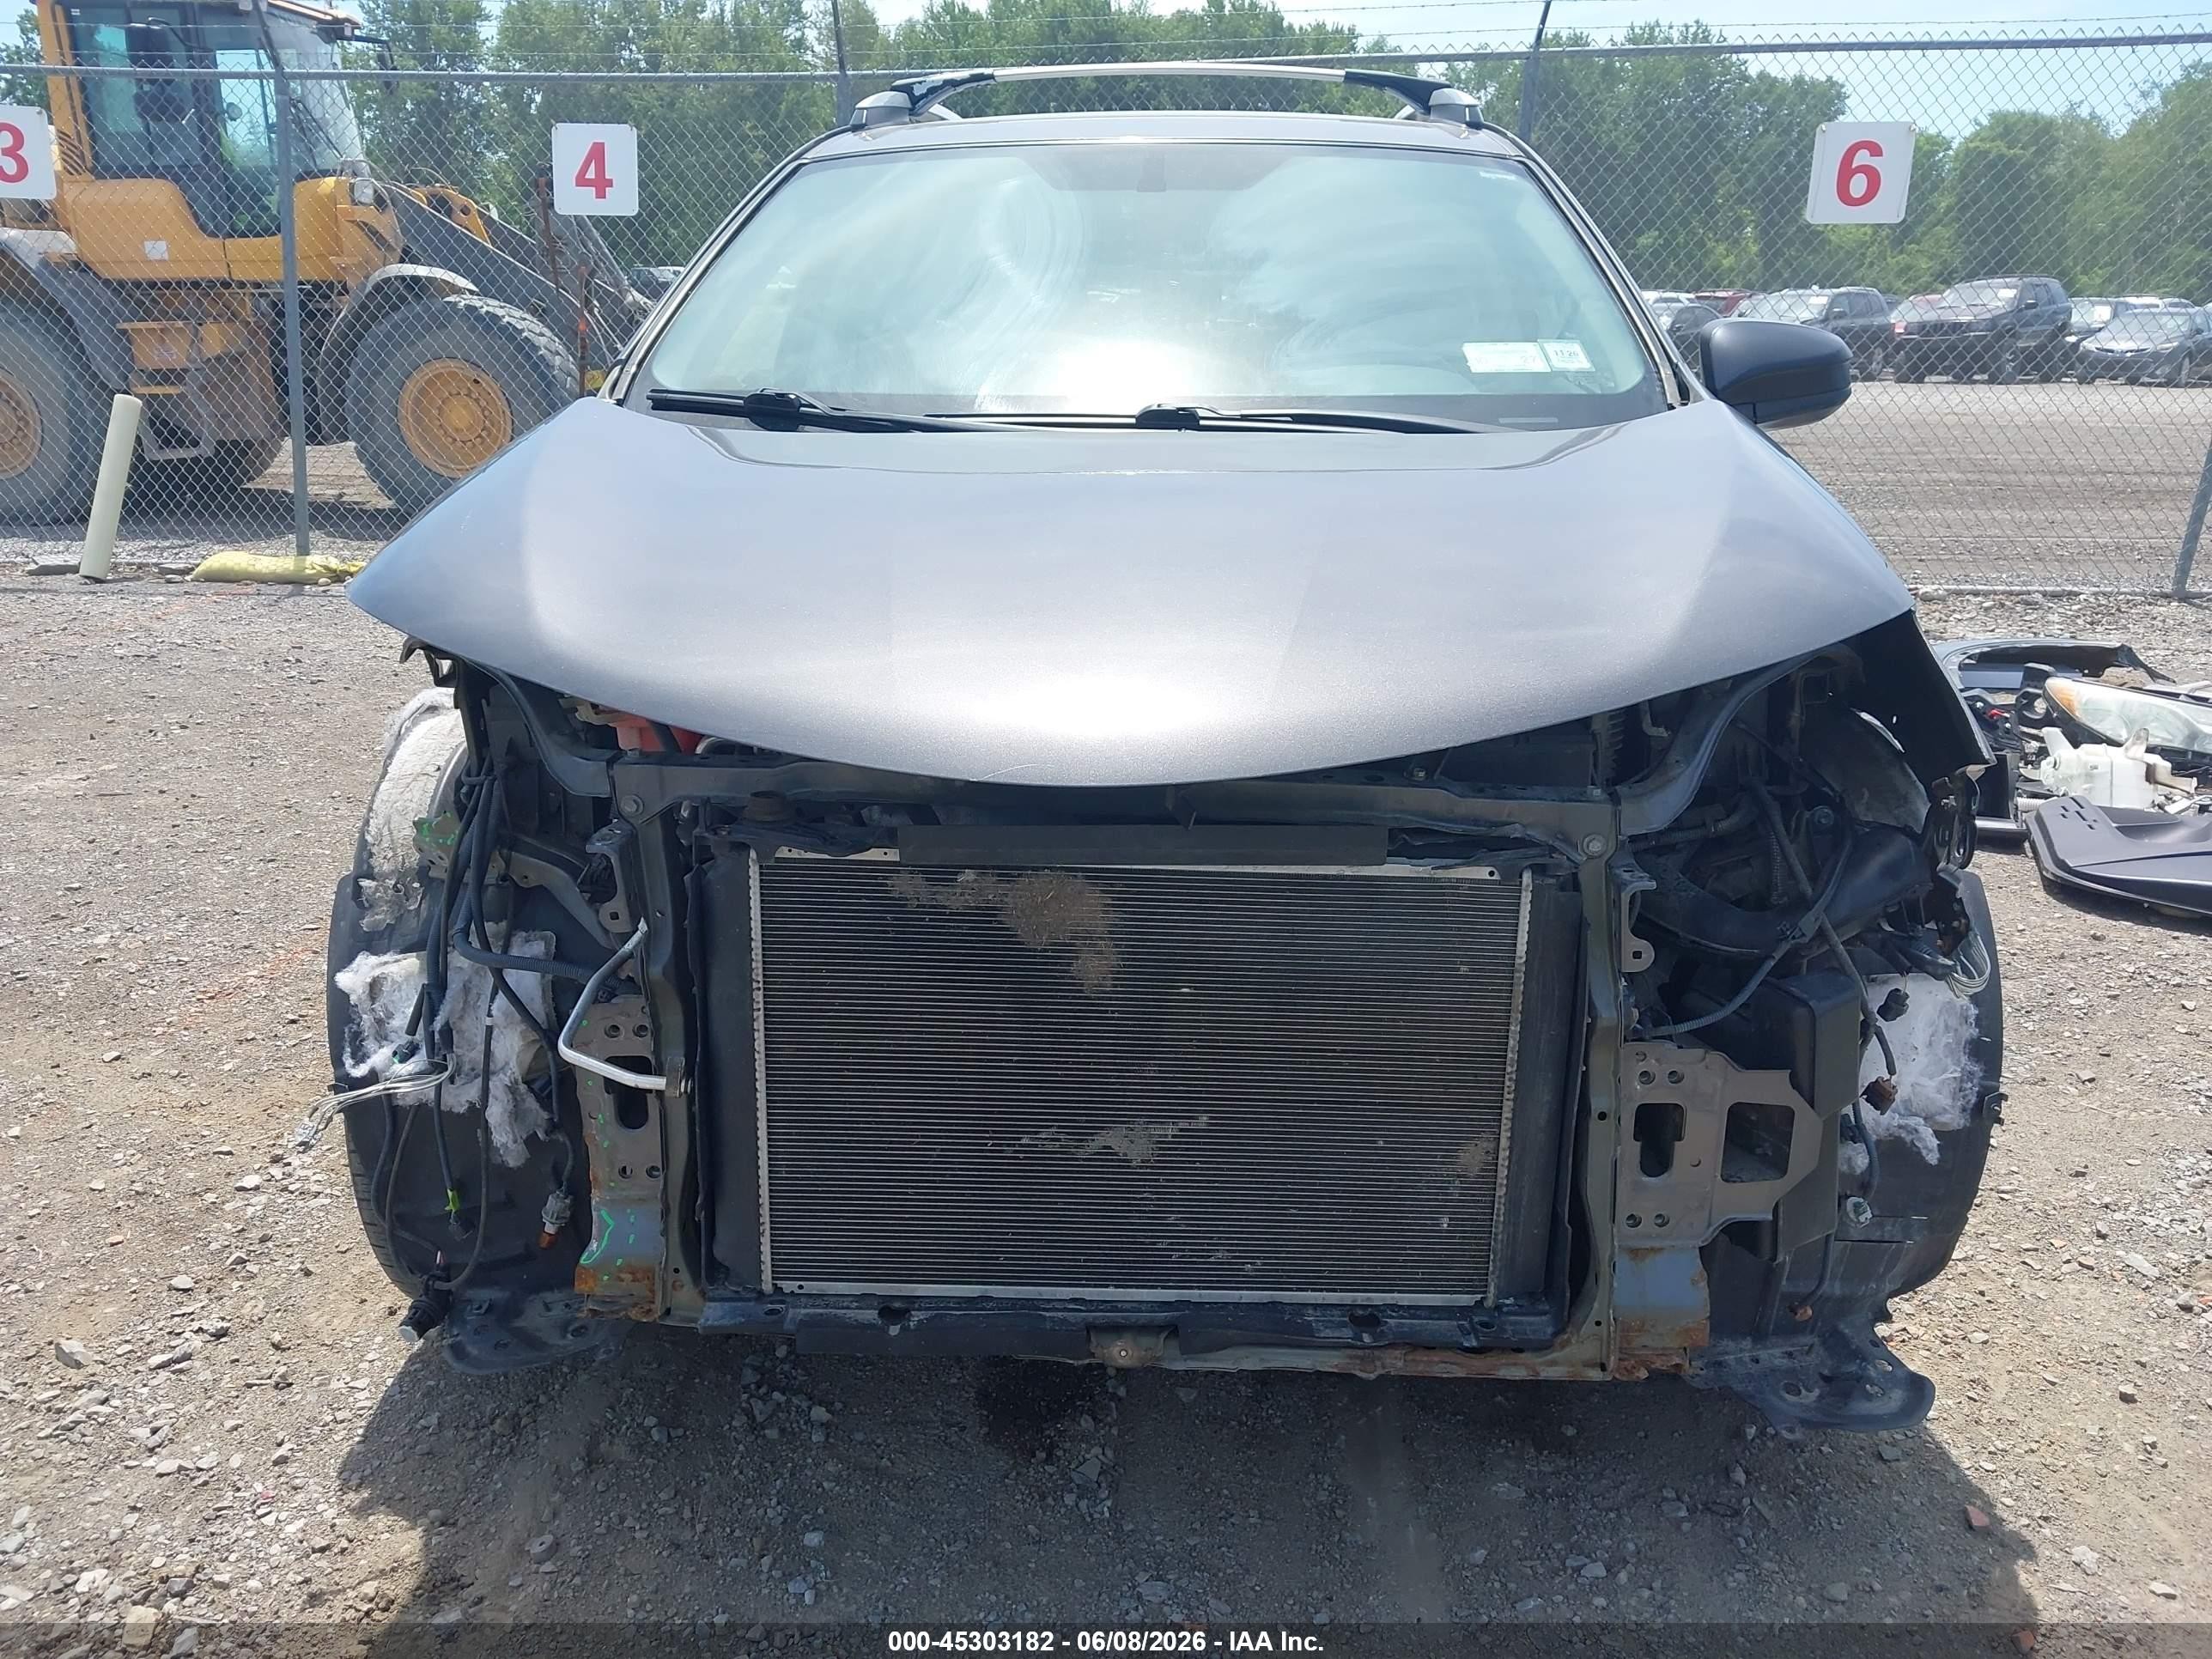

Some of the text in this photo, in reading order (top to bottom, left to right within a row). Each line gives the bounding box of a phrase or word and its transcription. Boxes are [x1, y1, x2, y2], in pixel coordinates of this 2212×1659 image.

[0, 123, 28, 182] 3
[575, 143, 613, 198] 4
[1836, 141, 1883, 206] 6
